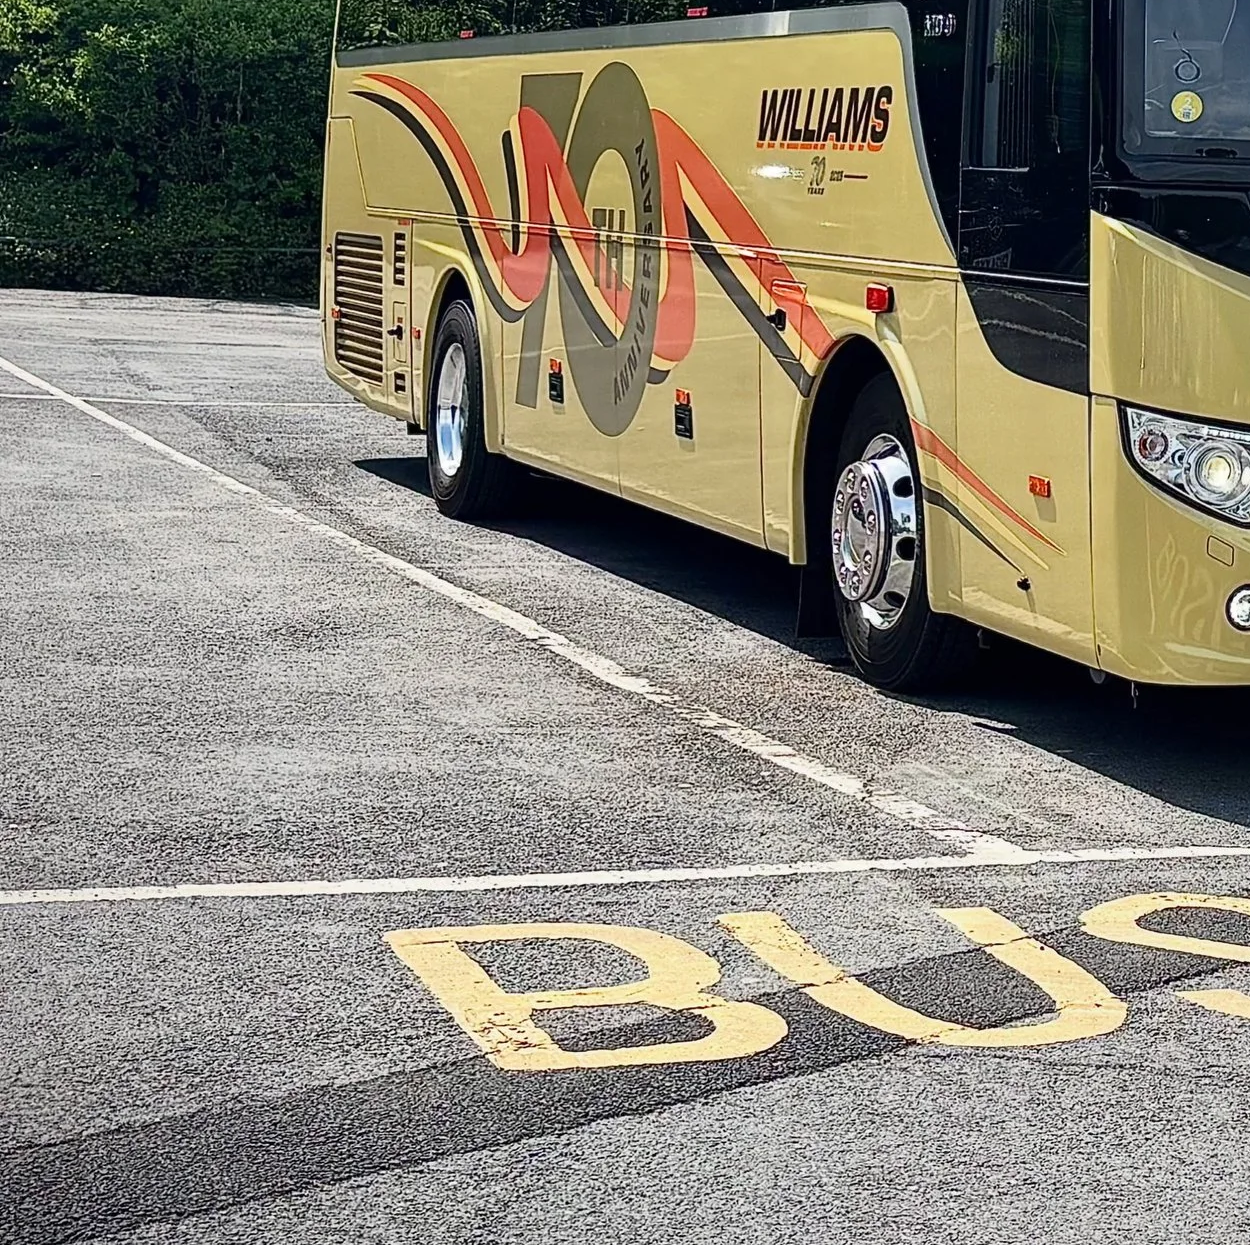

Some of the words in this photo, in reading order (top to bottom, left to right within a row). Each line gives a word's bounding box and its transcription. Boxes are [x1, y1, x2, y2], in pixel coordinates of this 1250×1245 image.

[515, 60, 661, 438] 70
[756, 85, 893, 152] WILLIAMS
[614, 138, 654, 406] ANNIVERSARY
